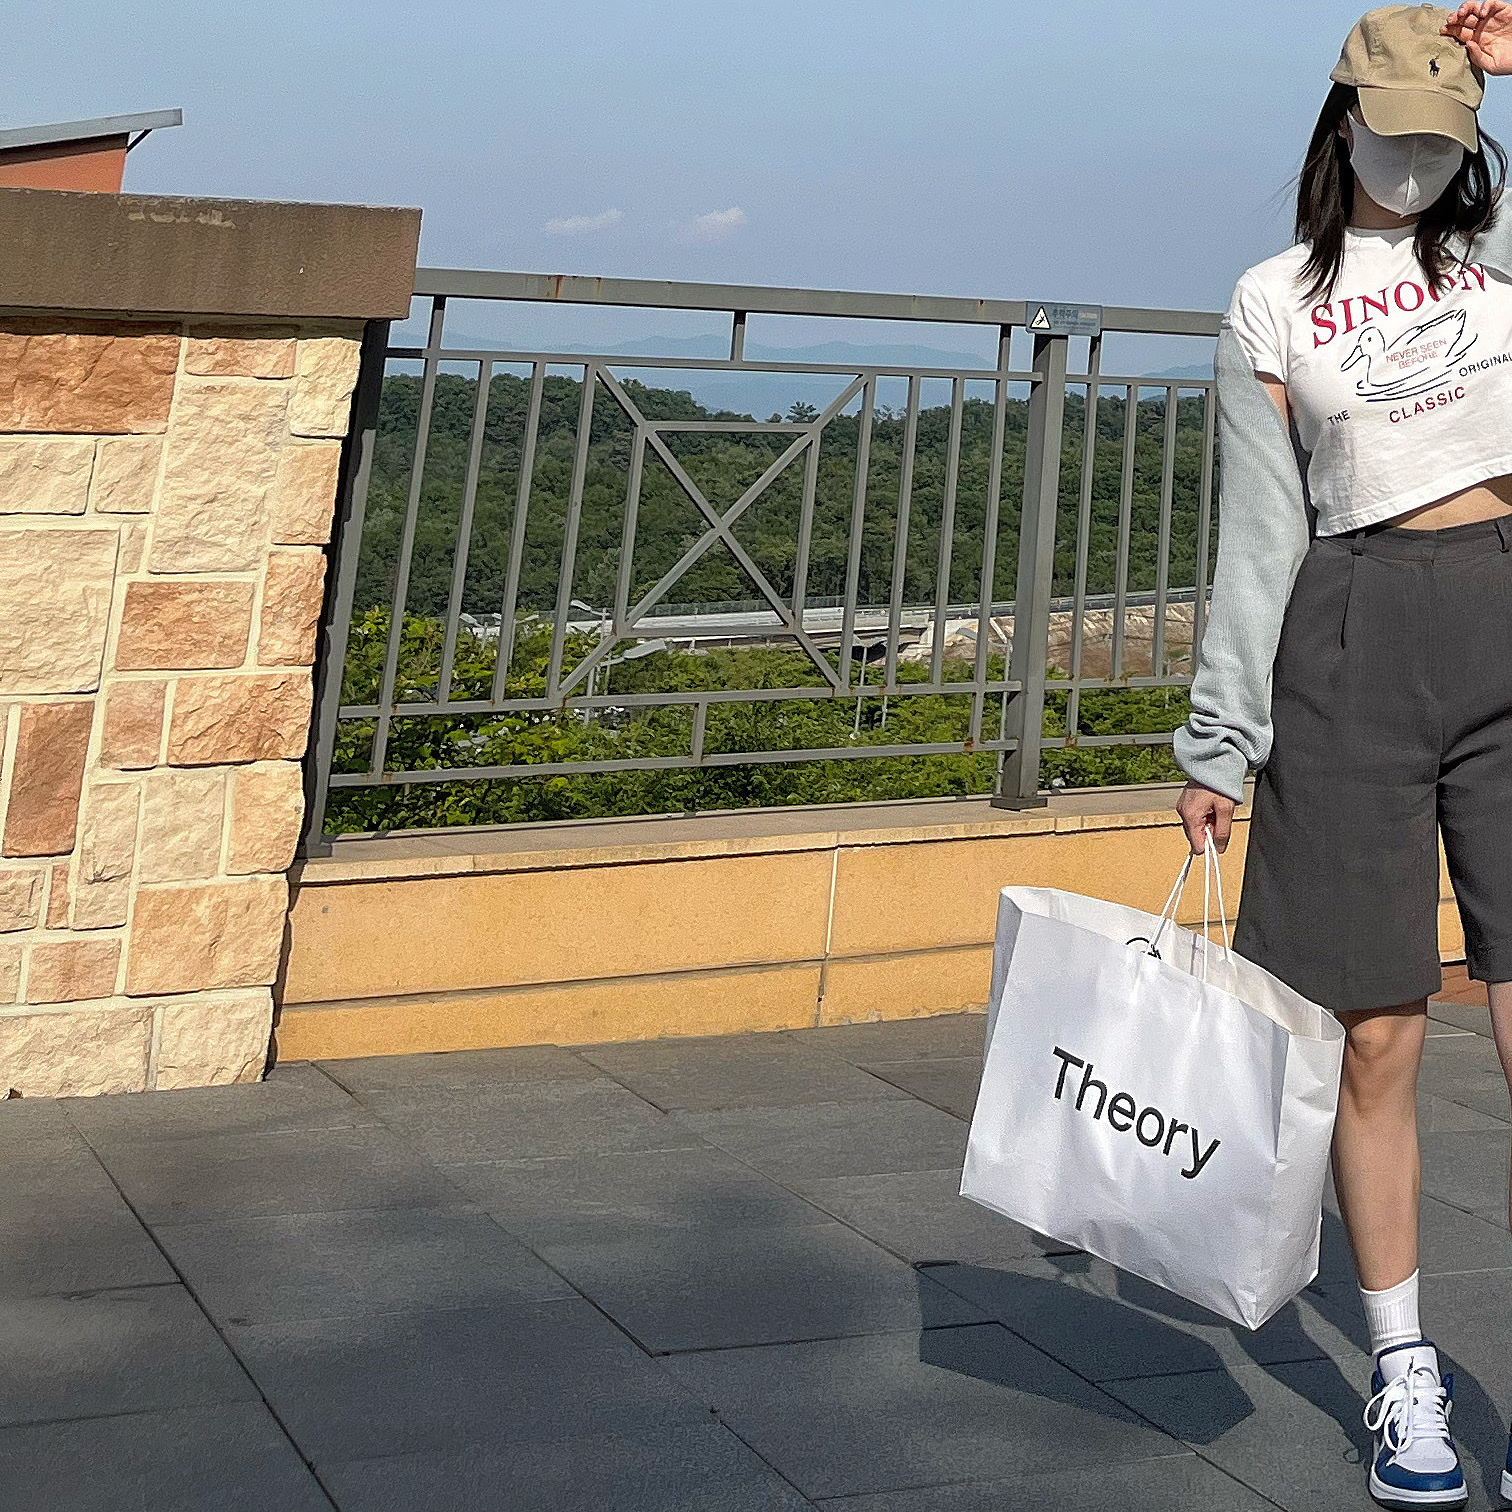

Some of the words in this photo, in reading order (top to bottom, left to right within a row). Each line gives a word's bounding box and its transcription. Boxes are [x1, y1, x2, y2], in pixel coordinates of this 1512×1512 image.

[1385, 345, 1419, 363] NEVER
[1420, 338, 1447, 353] SEEN
[1327, 410, 1350, 425] THE
[1389, 386, 1466, 423] CLASSIC
[1053, 1046, 1221, 1179] Theory
